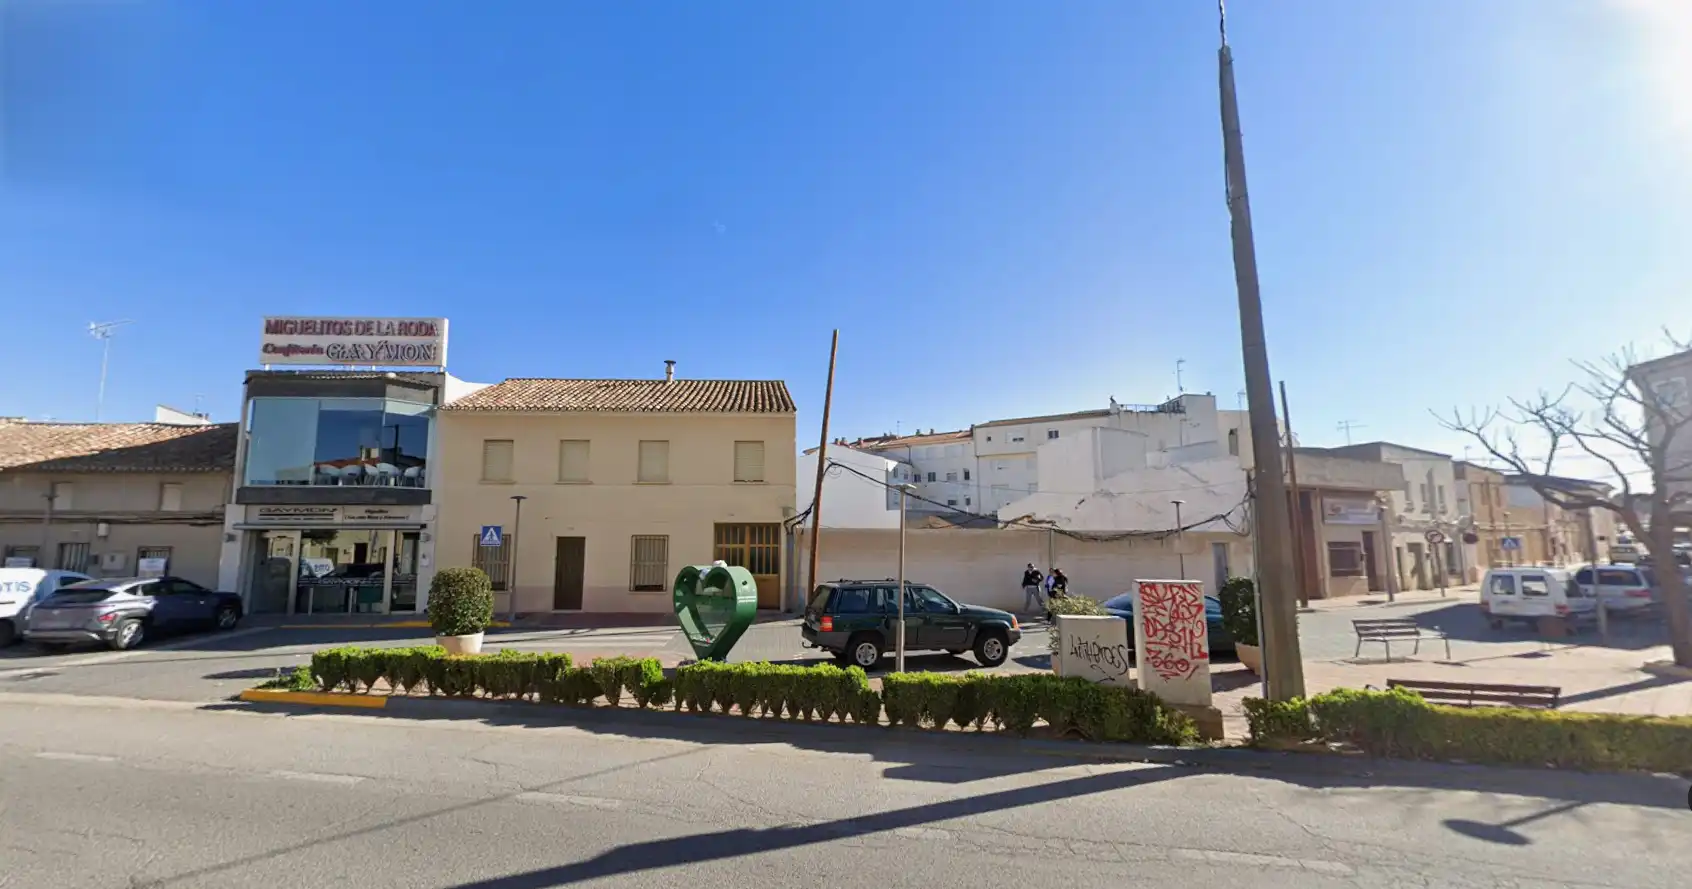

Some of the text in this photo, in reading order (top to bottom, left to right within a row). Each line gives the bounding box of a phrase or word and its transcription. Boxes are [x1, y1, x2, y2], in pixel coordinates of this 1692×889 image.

[265, 319, 438, 337] MIGUELITOS DE LA RODA
